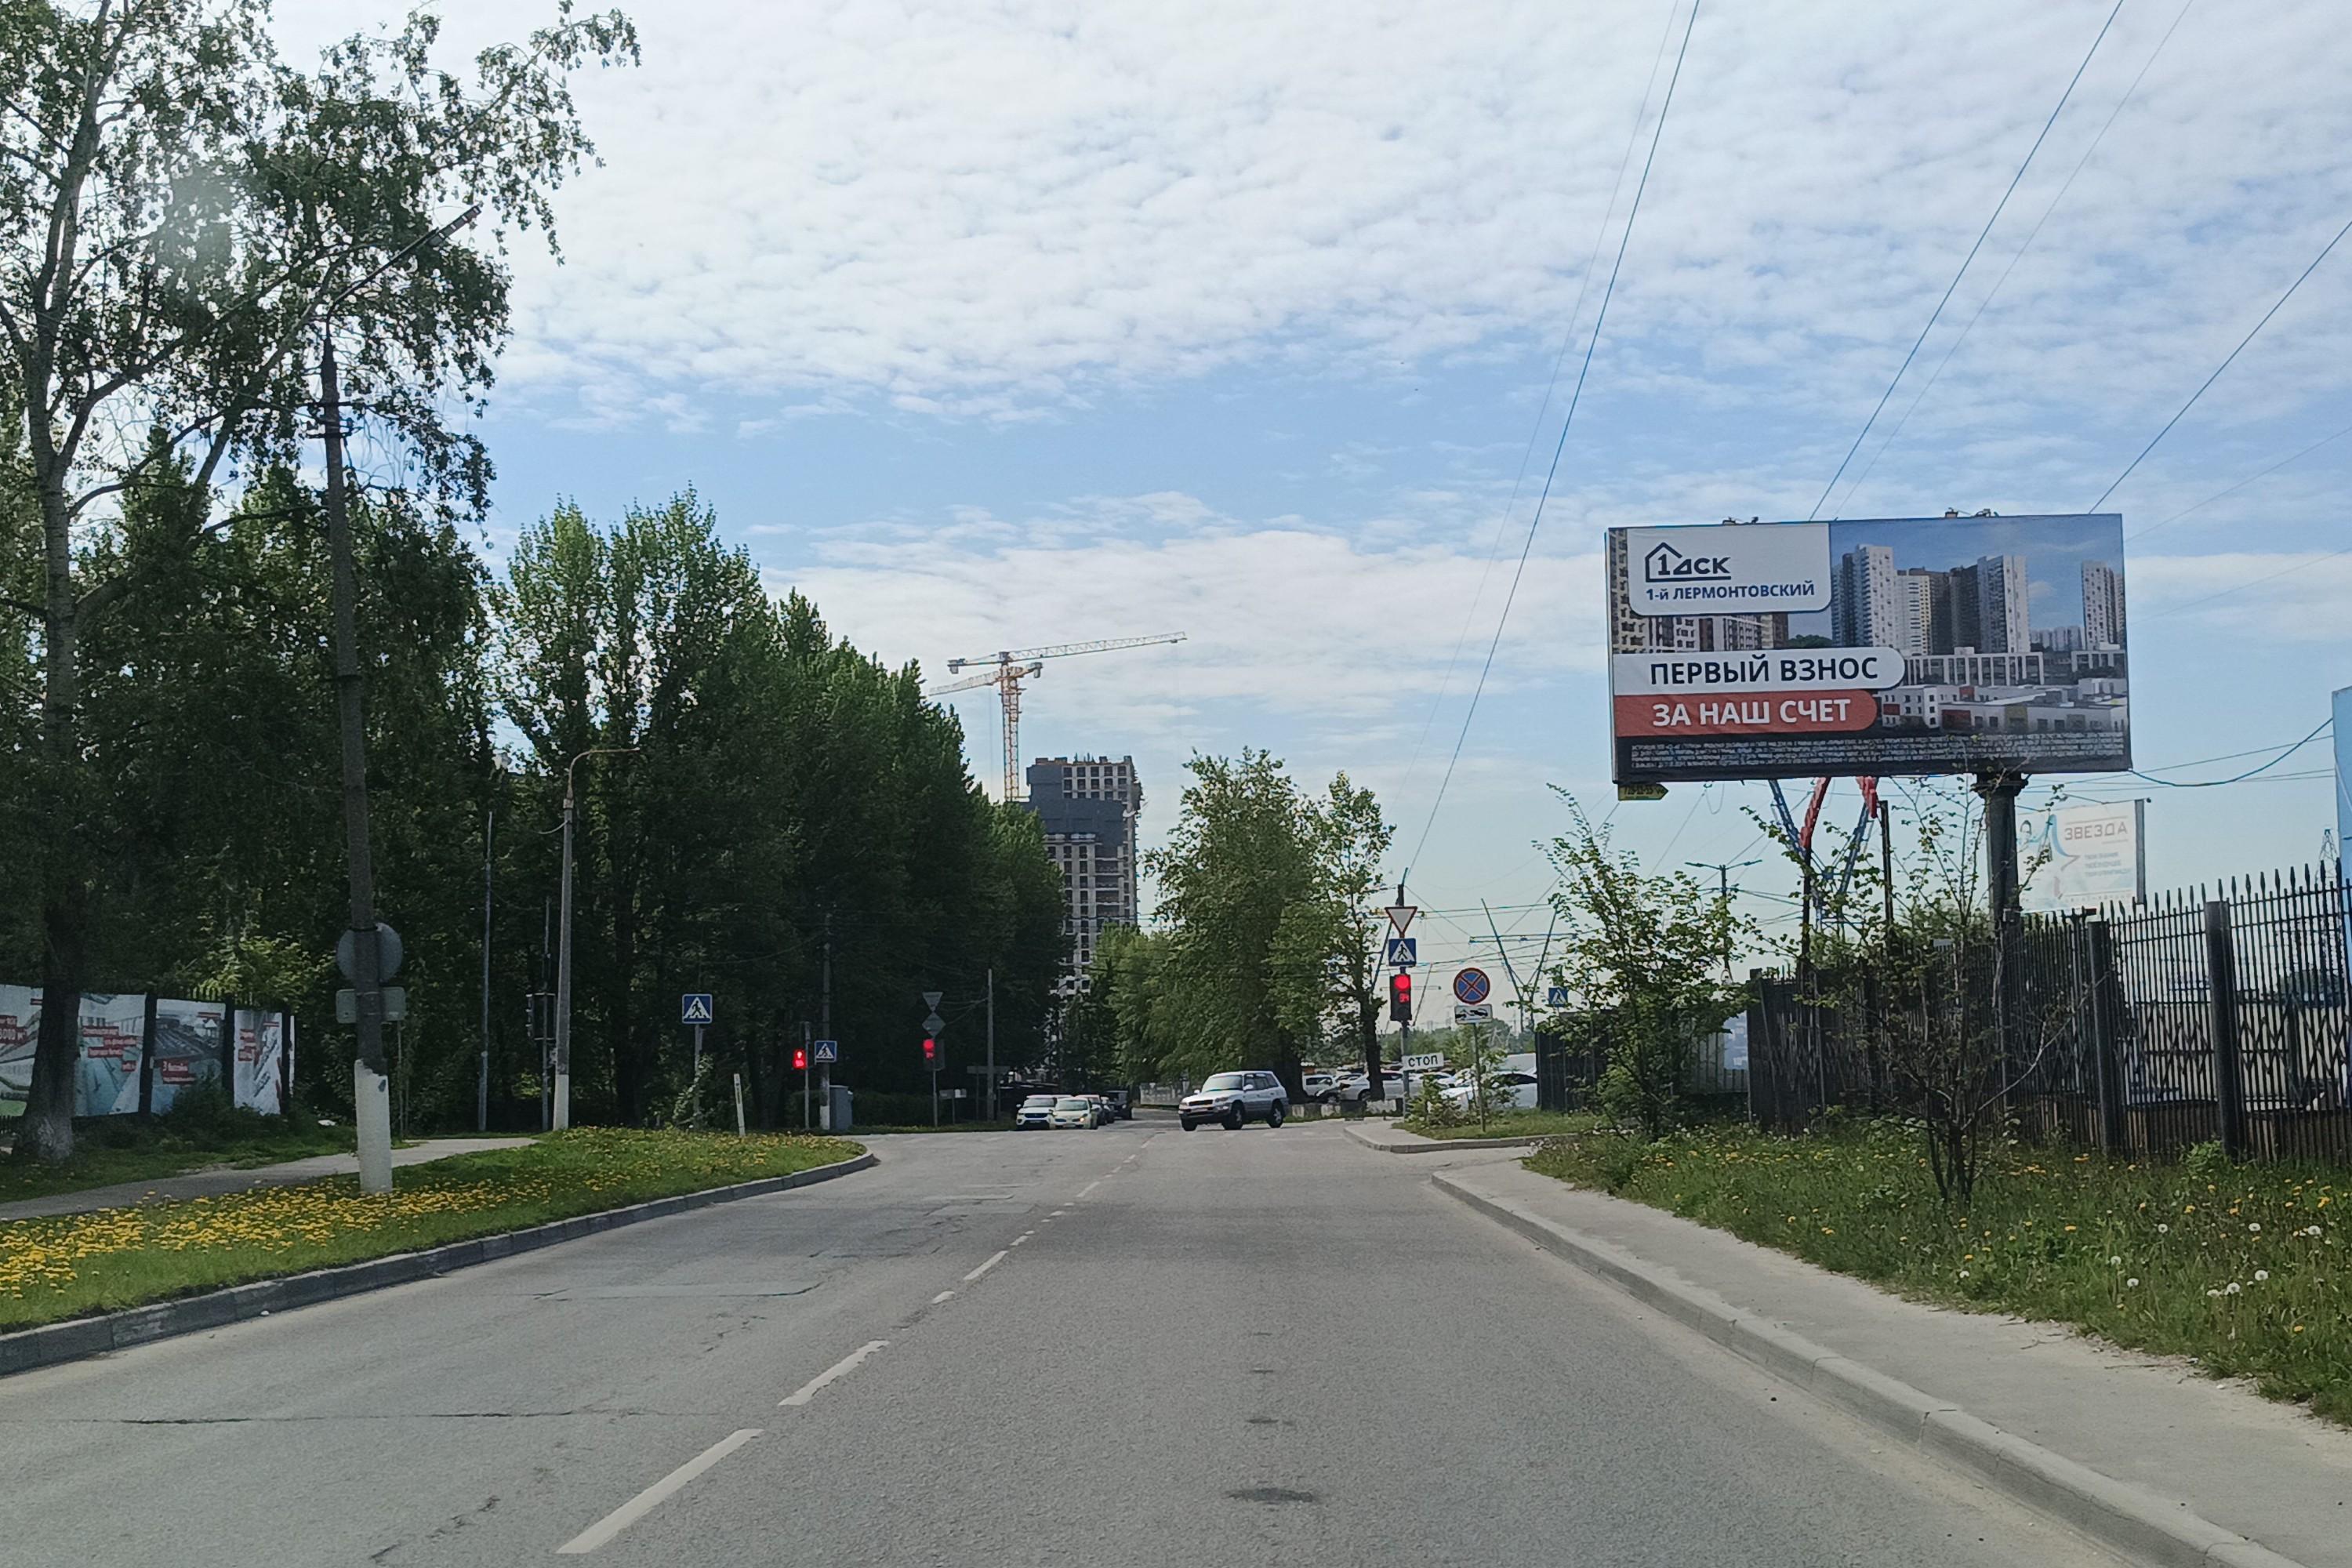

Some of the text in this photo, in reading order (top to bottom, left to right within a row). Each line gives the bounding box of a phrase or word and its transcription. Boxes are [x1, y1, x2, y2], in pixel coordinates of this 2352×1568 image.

[1646, 580, 1815, 601] 1-й ЛЕРМОНТОВСКИЙ
[1650, 653, 1878, 685] ПЕРВЫЙ ВЗНОС
[1653, 698, 1851, 727] ЗА НАШ СЧЕТ
[2063, 821, 2129, 840] ЗВЕЗДА
[1408, 1054, 1439, 1067] СТОП
